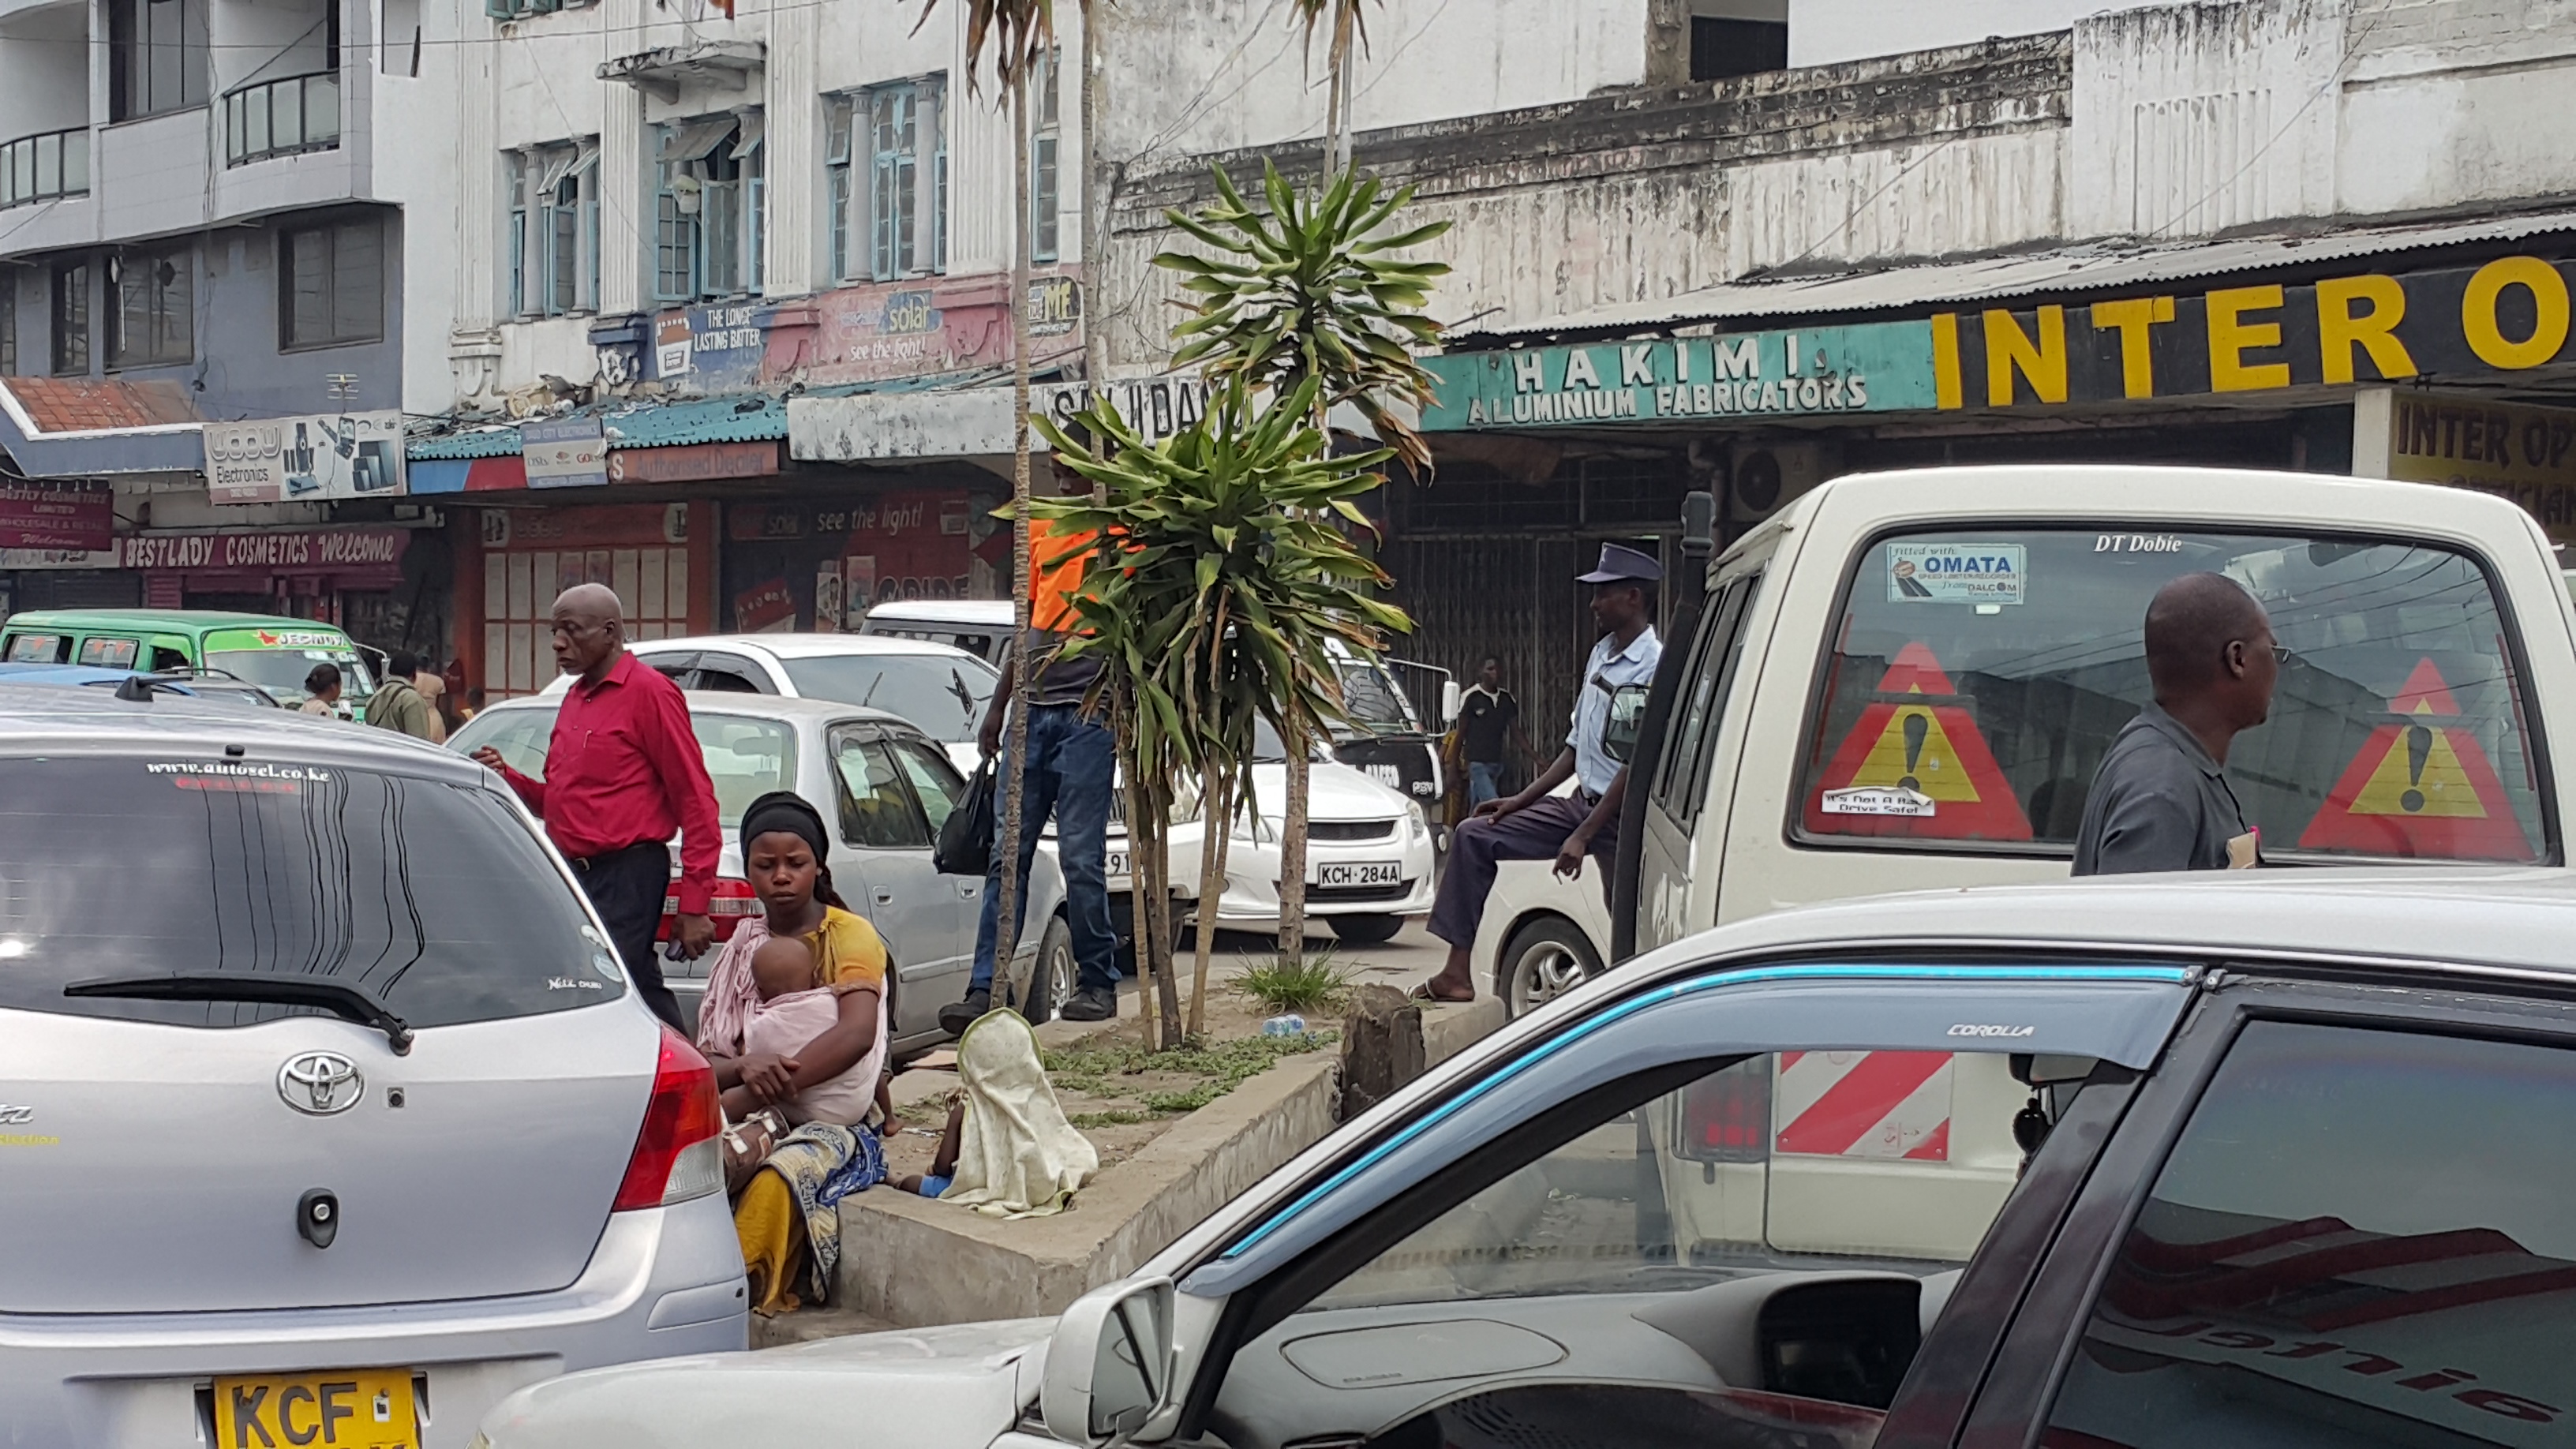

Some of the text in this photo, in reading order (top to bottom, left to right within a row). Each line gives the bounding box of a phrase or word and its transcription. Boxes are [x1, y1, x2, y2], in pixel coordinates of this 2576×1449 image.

[707, 309, 724, 328] THE
[889, 298, 930, 331] solar
[694, 331, 728, 352] LASTING
[850, 345, 869, 361] see
[873, 339, 890, 359] the
[1930, 274, 2419, 409] INTER
[1514, 334, 1799, 393] HAKIMI
[1467, 376, 1867, 425] ALUMINIUM FABRICATORS
[2398, 402, 2511, 470] INTER
[217, 463, 269, 483] Electronics
[715, 445, 766, 474] Dealer
[816, 512, 845, 533] see
[851, 505, 876, 530] the
[125, 529, 395, 567] BESTLADY COSMETICS Welcome
[2094, 534, 2182, 553] DT Dobie
[1924, 556, 2011, 573] OMATA
[1839, 803, 1878, 812] Drive
[1946, 1024, 2035, 1038] COROLLA
[232, 1382, 358, 1448] KCF
